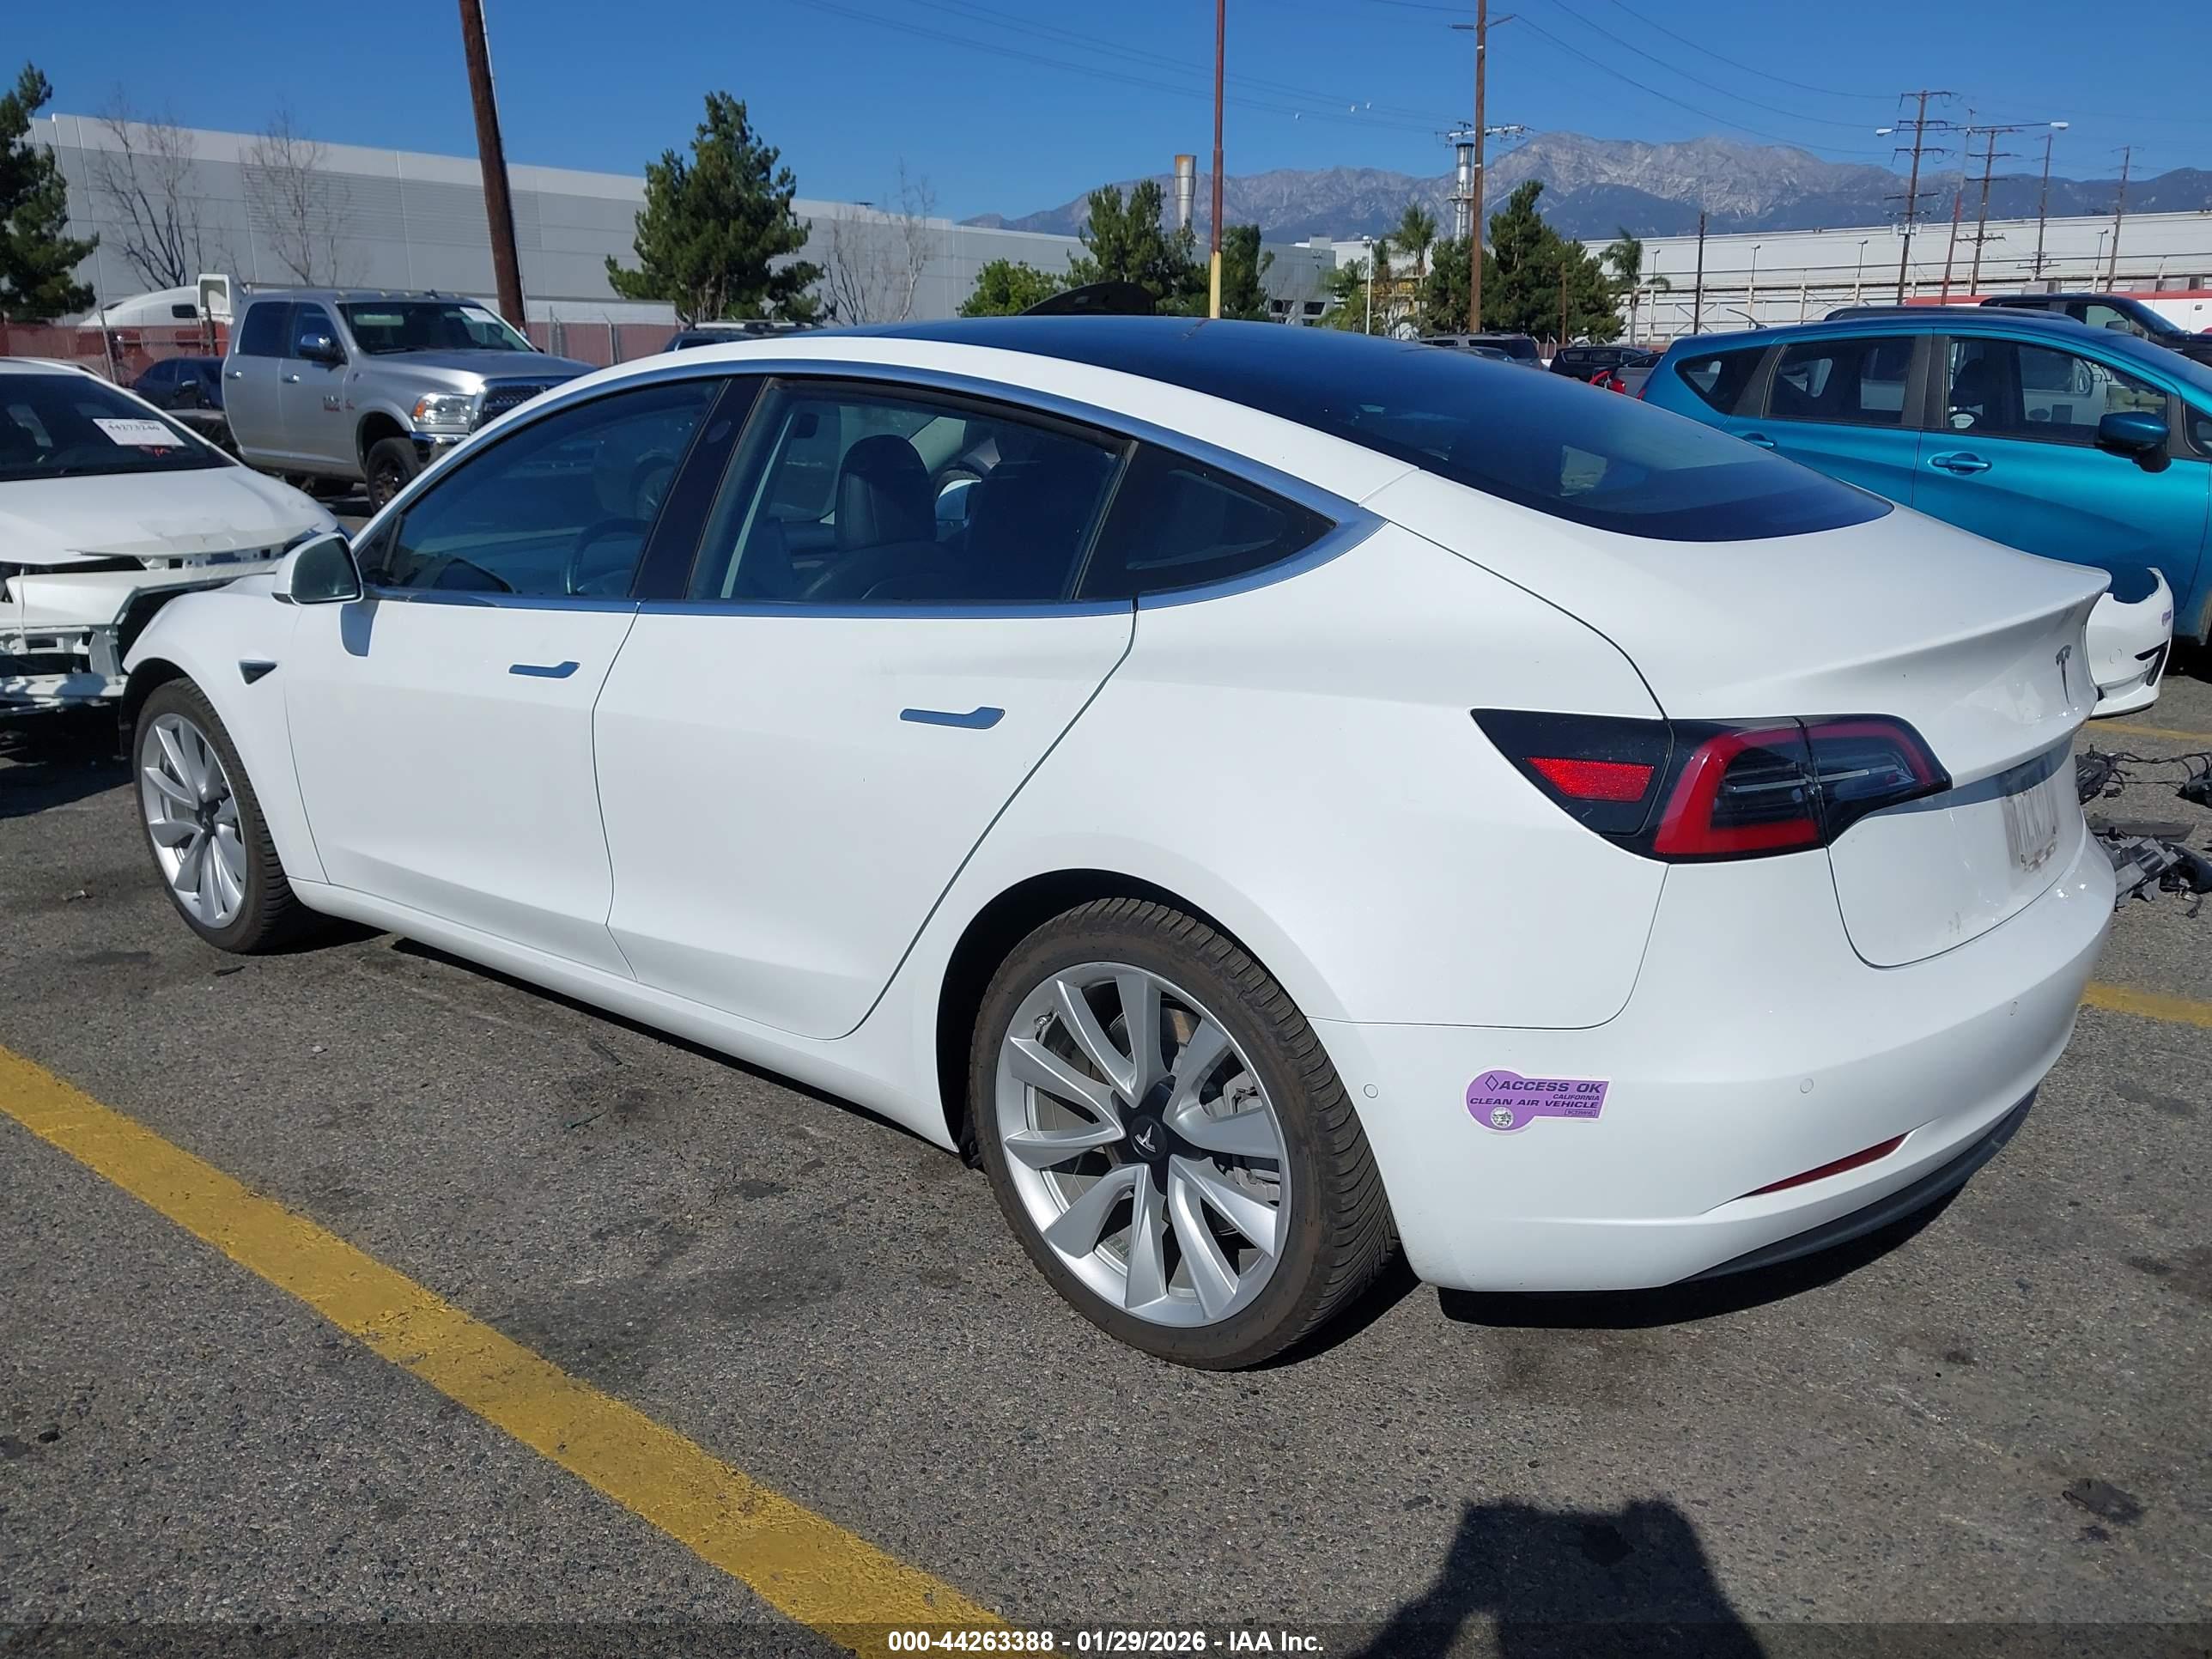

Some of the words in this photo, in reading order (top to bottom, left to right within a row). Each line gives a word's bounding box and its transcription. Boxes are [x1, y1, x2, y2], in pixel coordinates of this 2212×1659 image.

[1498, 1080, 1570, 1092] ACCESS
[1576, 1083, 1603, 1093] OK
[1516, 1098, 1540, 1107] AIR
[1545, 1100, 1598, 1109] VEHICLE
